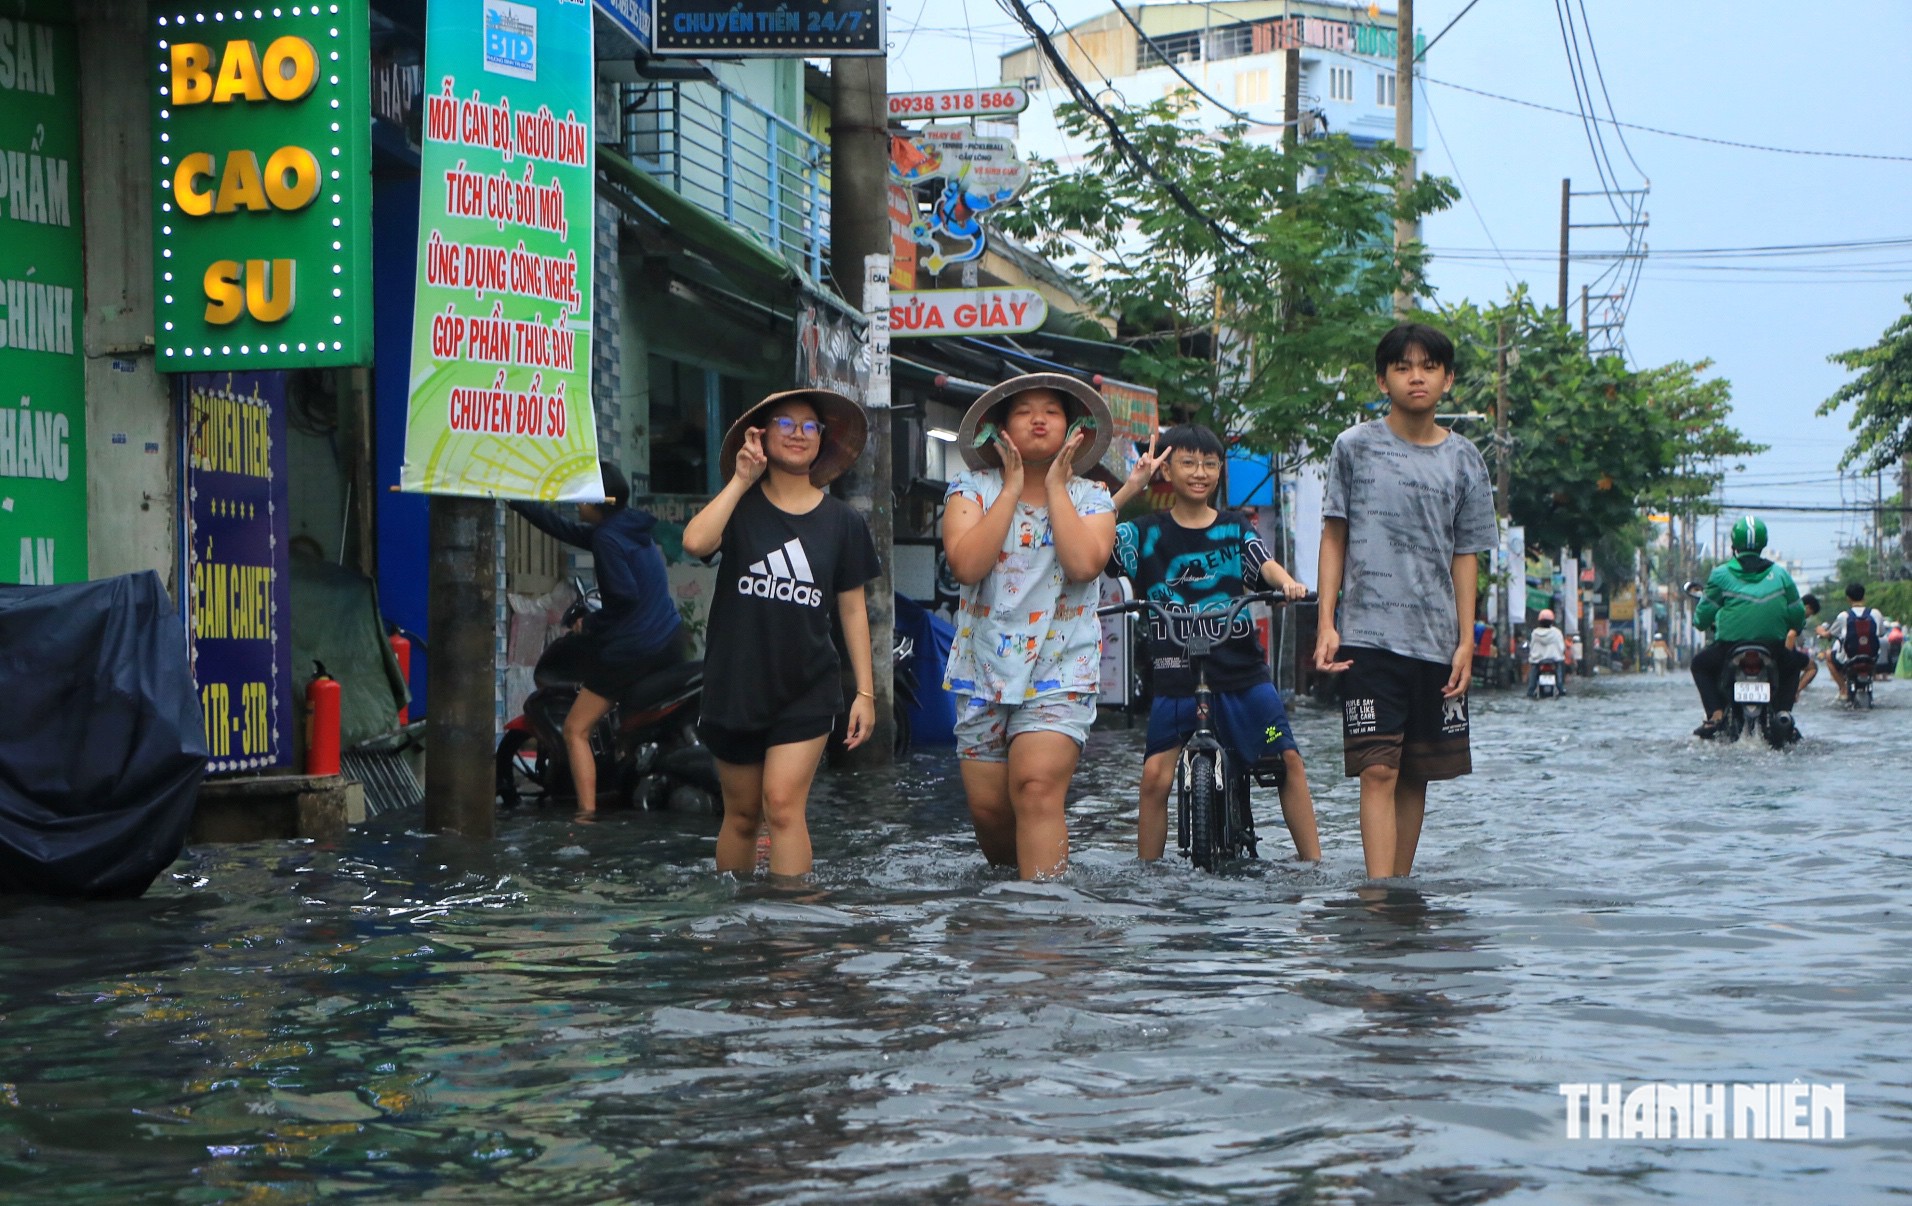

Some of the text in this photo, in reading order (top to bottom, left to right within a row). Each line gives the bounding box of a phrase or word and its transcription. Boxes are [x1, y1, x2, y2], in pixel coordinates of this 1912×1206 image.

[673, 2, 752, 33] CHUYỂN
[759, 3, 800, 32] TIỀN
[807, 11, 862, 33] 24/7
[171, 35, 320, 106] BAO
[889, 92, 1015, 113] 0938 318 586
[428, 78, 585, 166] MỖI CÁN BỘ, NGƯỜI DÂN
[173, 145, 321, 216] CAO
[447, 162, 566, 240] TÍCH CỰC ĐỔI MỚI,
[203, 258, 296, 325] SU
[427, 232, 580, 312] ỨNG DỤNG CÔNG NGHỆ,
[432, 302, 575, 371] GÓP PHẦN THÚC ĐẨY
[889, 296, 945, 330] SỬA
[953, 296, 1029, 328] GIÀY
[450, 370, 566, 438] CHUYỂN ĐỔI SỐ
[196, 536, 271, 639] CẦM CAVET
[738, 574, 823, 608] adidas
[203, 683, 230, 757] 1TR
[242, 682, 268, 755] 3TR
[1360, 706, 1375, 714] LIKE
